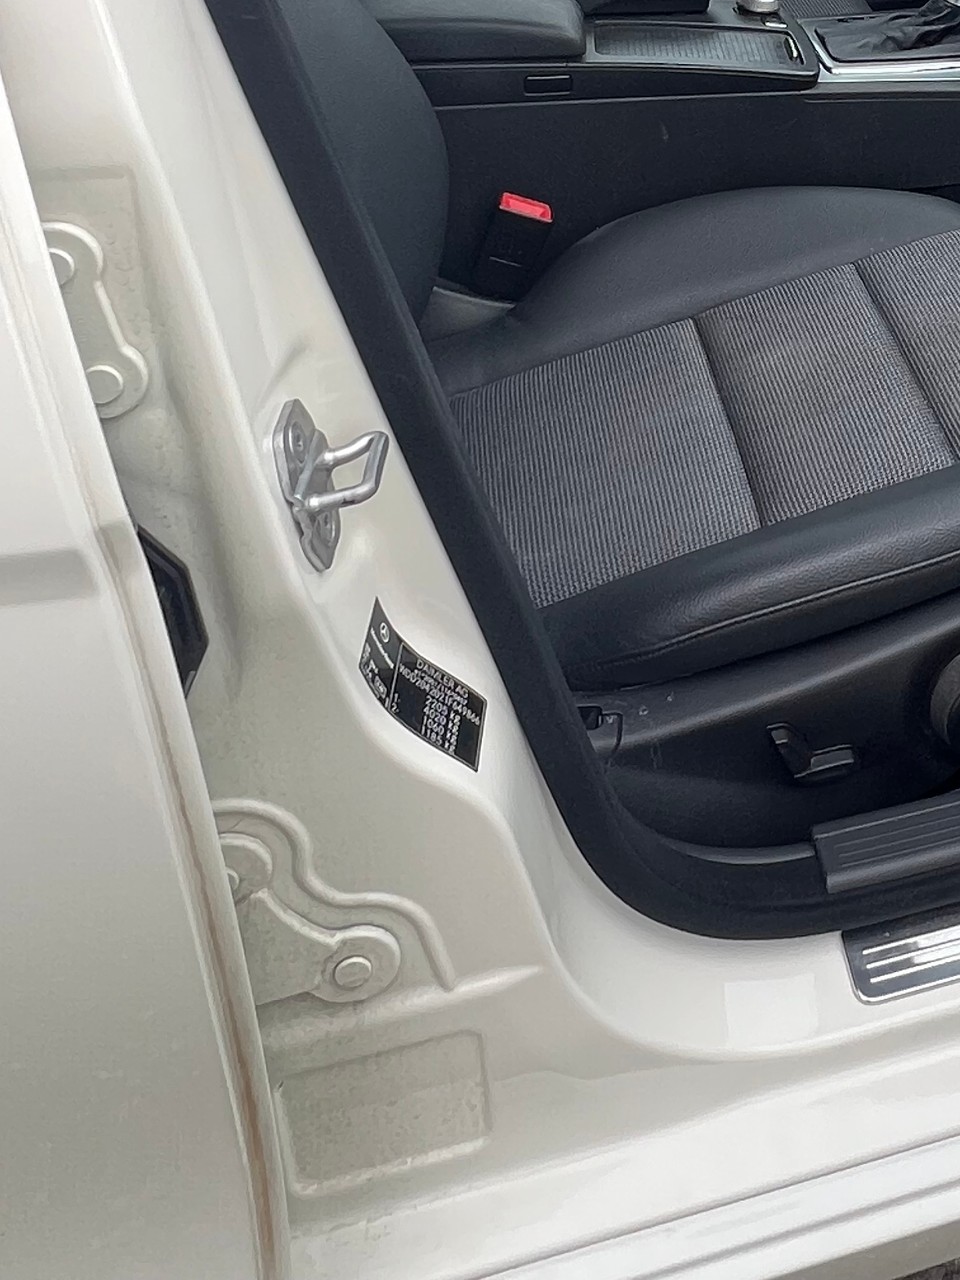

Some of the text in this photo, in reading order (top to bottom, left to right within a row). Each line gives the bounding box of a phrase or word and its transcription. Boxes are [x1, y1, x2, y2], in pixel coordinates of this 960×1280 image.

[416, 658, 469, 699] DAIMLER AG
[423, 706, 447, 726] 4020
[425, 695, 448, 716] 2205
[421, 725, 443, 746] 1185
[423, 715, 445, 735] 1060
